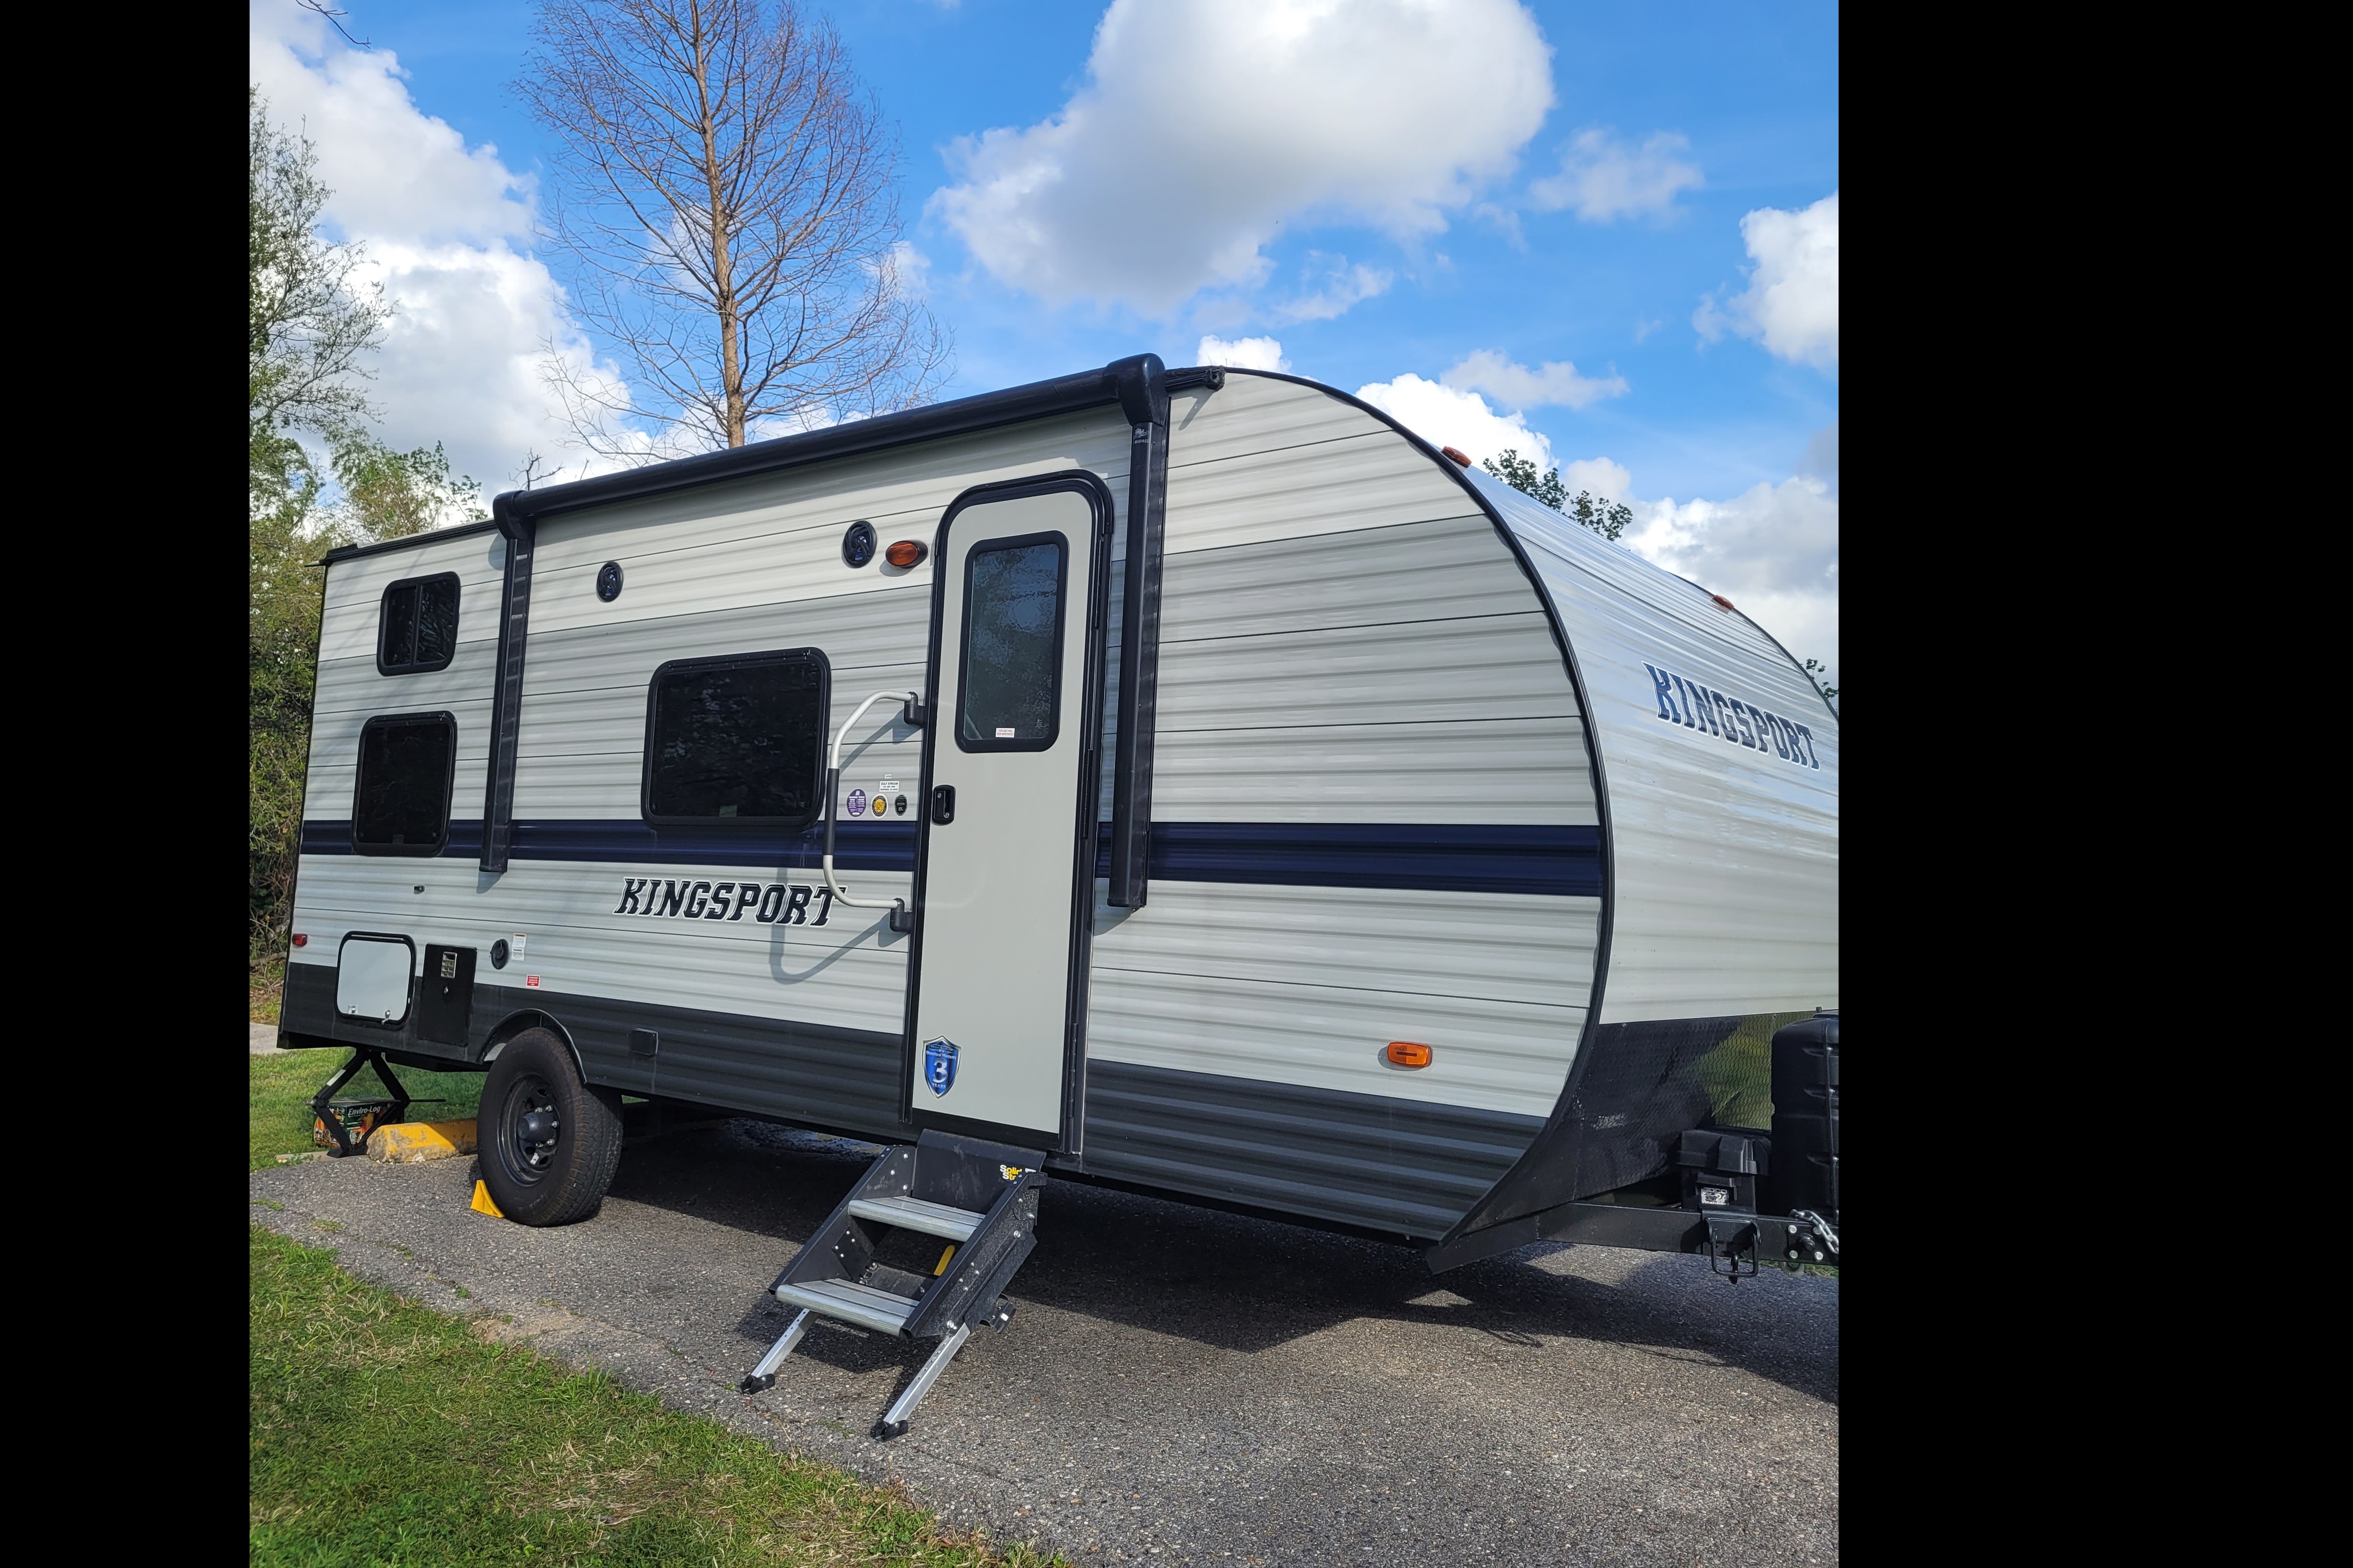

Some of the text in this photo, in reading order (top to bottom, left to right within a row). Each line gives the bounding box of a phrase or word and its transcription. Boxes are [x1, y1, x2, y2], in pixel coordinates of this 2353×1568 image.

[1642, 660, 1820, 772] KINGSPORT
[613, 877, 849, 928] KINGSPORT
[933, 1057, 948, 1083] 3
[347, 1106, 382, 1115] Enviro-Log
[1002, 1171, 1017, 1181] St
